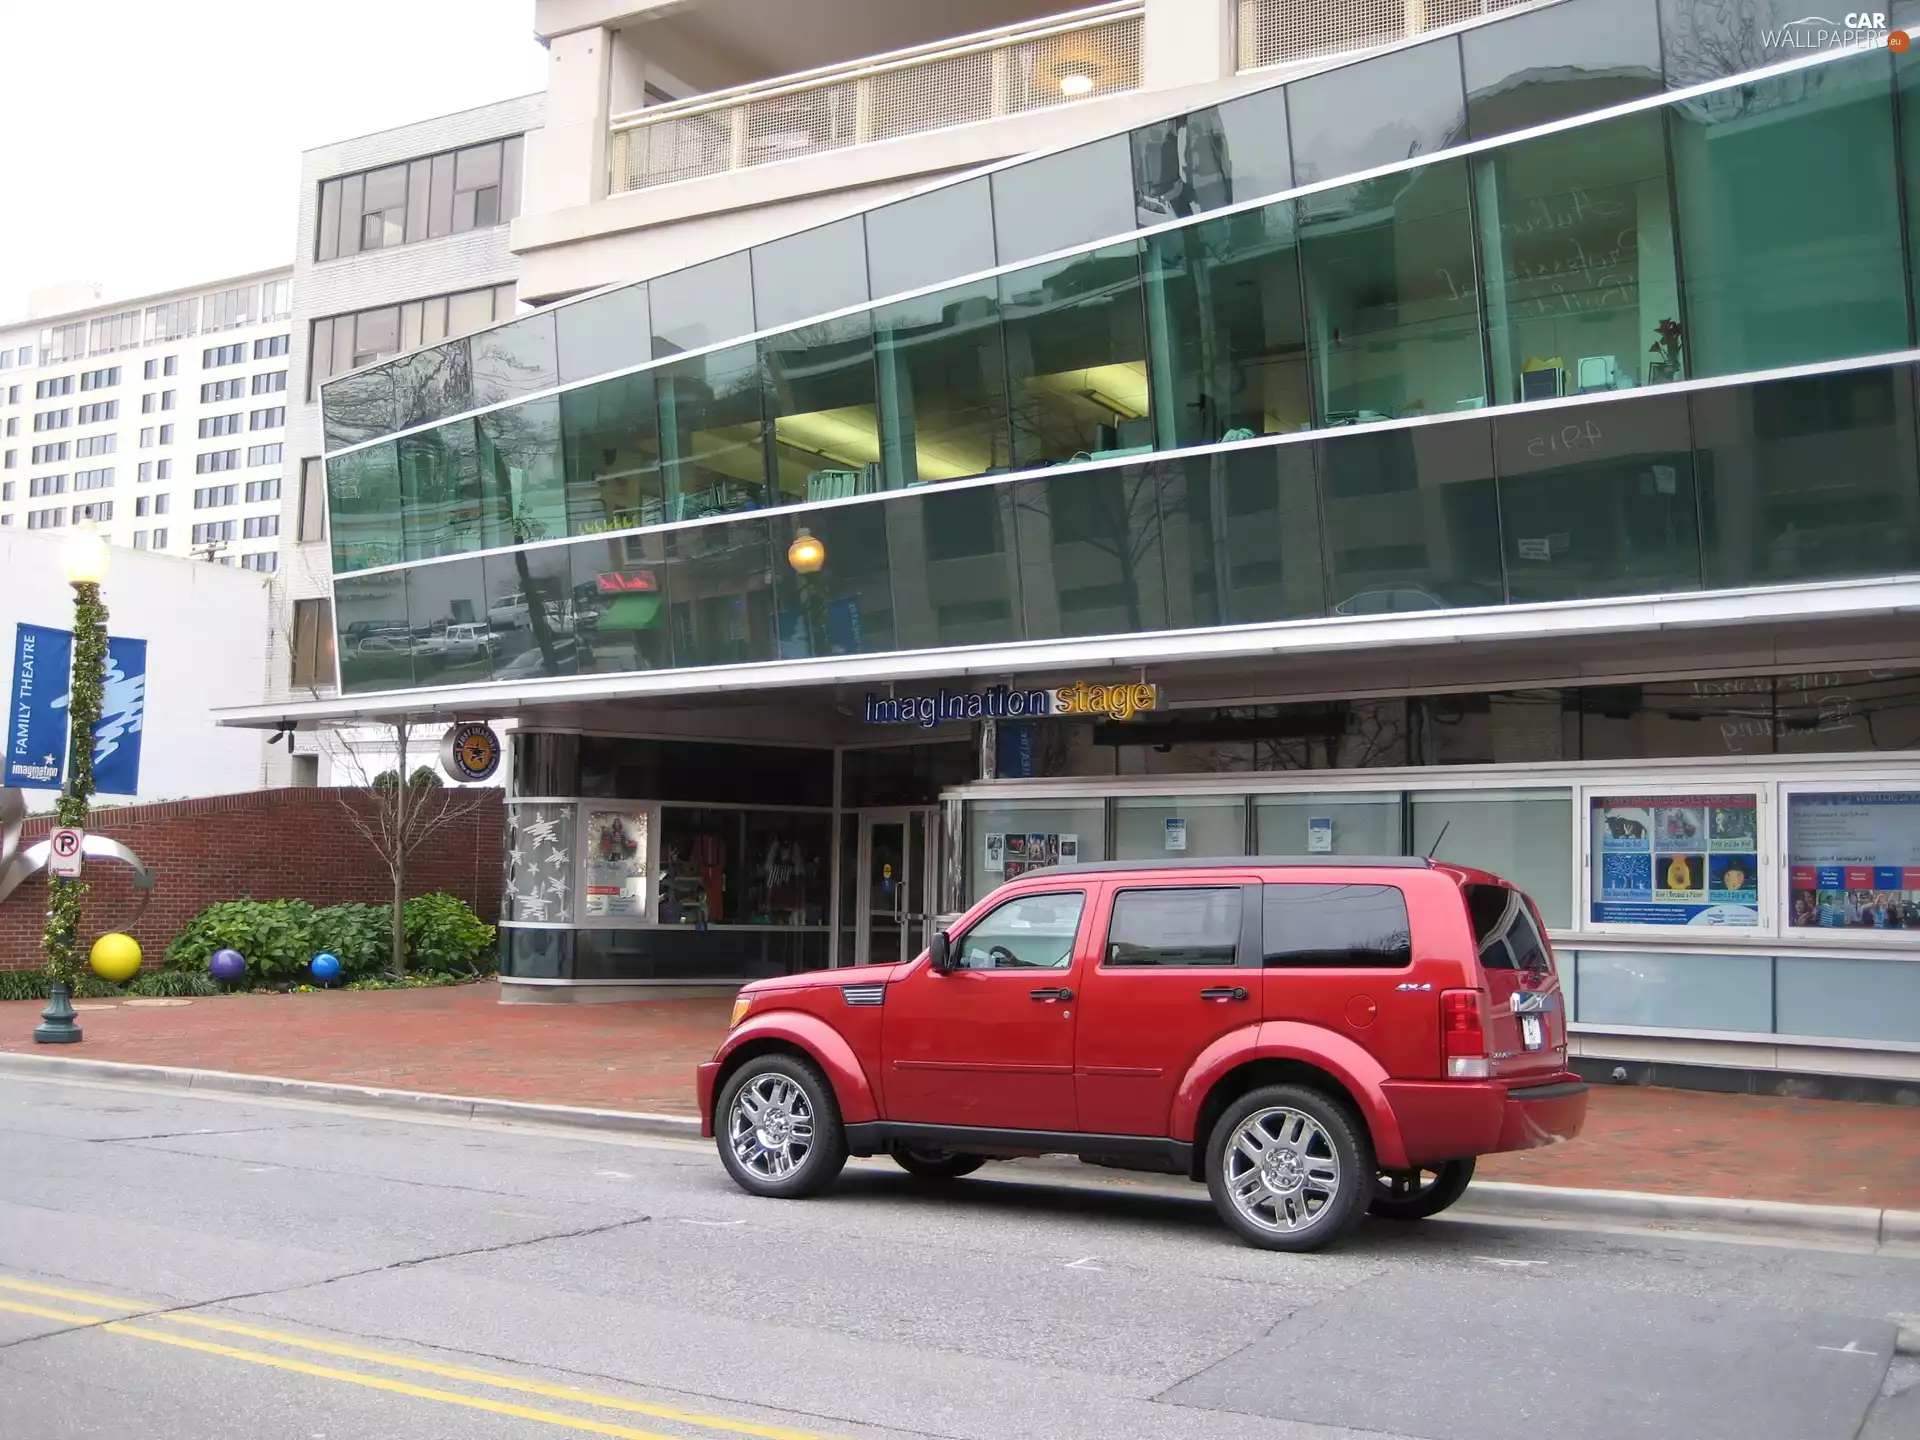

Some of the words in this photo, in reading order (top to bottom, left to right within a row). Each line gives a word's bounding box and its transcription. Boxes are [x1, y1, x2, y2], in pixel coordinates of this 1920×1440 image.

[20, 634, 36, 699] THEATRE
[16, 700, 31, 755] FAMILY
[1055, 680, 1154, 720] stage
